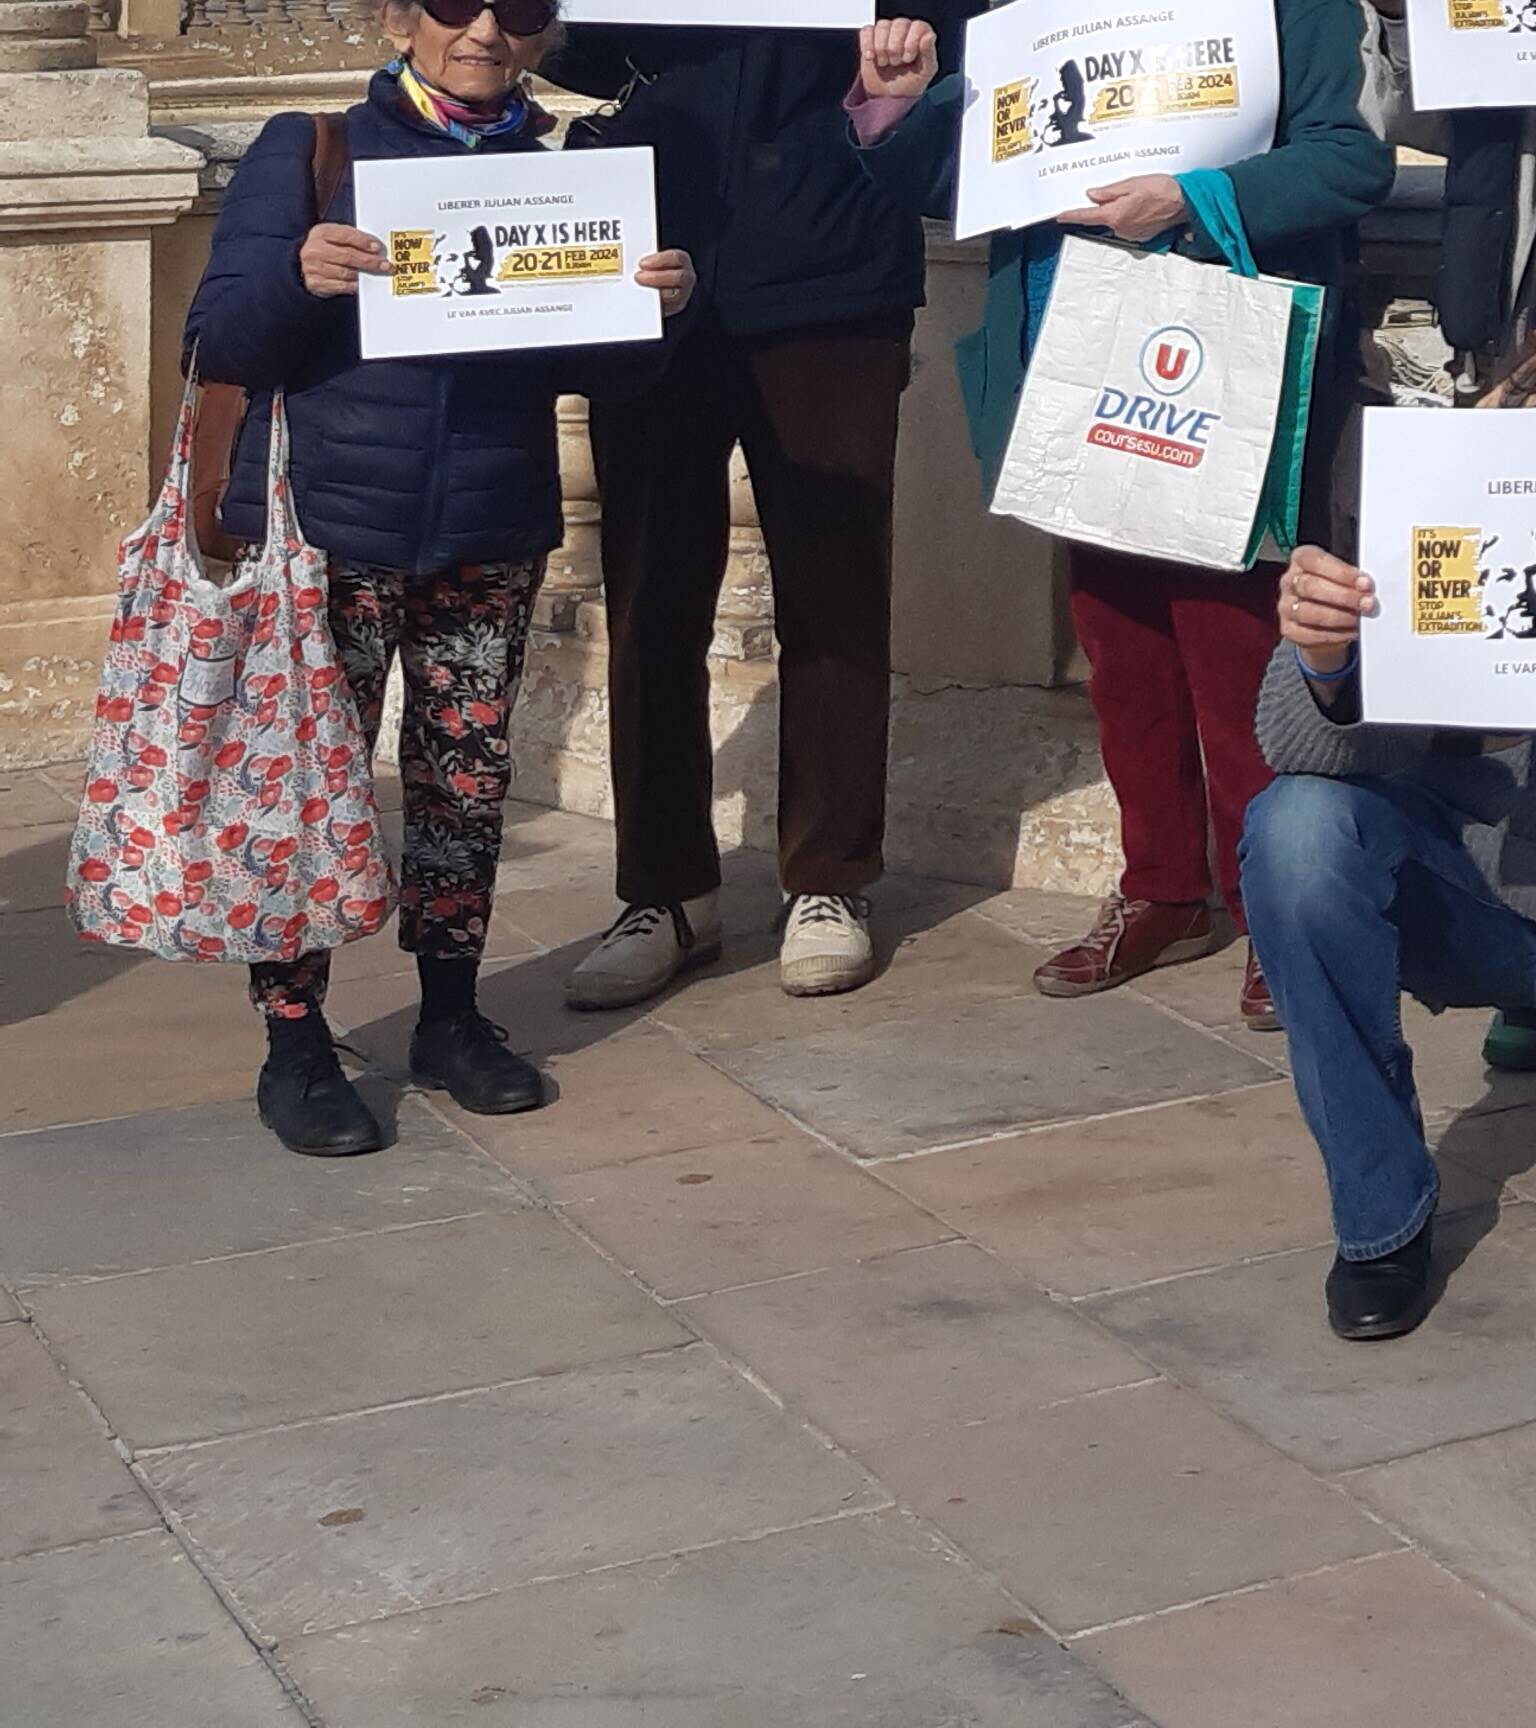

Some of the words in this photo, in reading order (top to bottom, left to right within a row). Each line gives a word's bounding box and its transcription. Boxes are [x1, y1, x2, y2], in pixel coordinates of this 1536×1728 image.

[1084, 50, 1126, 82] DAY
[1128, 48, 1146, 74] X
[494, 224, 532, 248] DAY
[533, 224, 547, 246] X
[552, 223, 570, 244] IS
[574, 220, 621, 243] HERE
[511, 250, 562, 273] 20-21
[564, 249, 586, 262] FEB
[589, 247, 619, 260] 2024
[1154, 343, 1190, 381] U
[1094, 386, 1222, 445] DRIVE
[1093, 426, 1195, 465] coursesu.com
